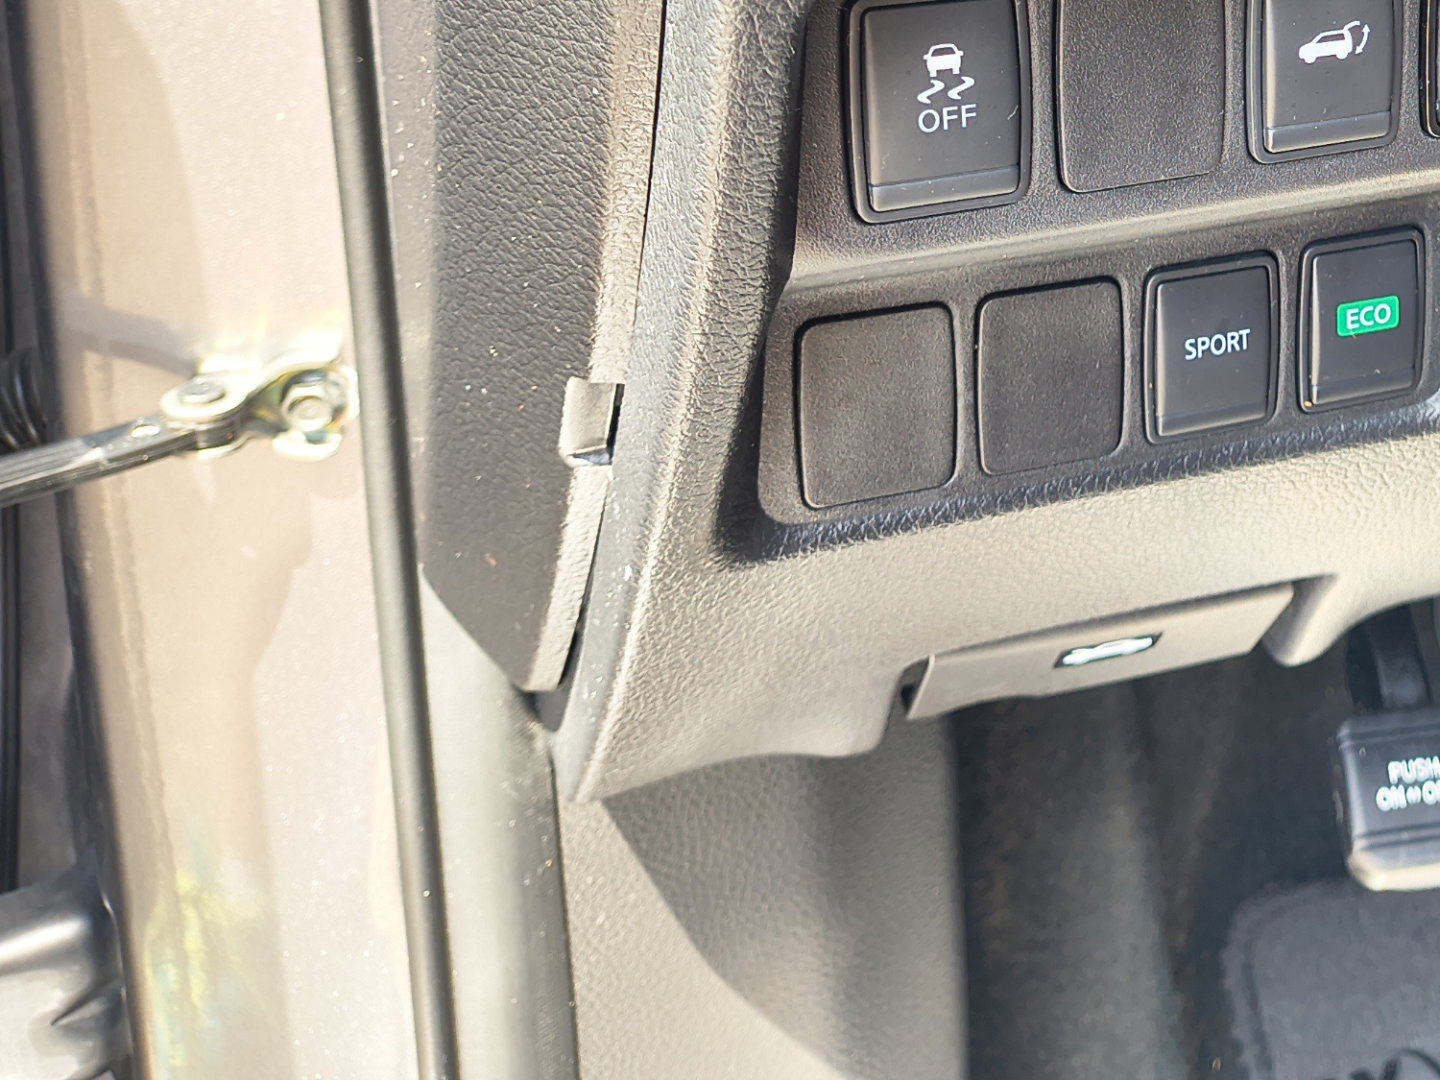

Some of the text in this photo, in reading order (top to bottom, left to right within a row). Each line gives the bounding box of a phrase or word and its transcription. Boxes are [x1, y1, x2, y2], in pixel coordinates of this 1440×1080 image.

[918, 103, 977, 133] OFF
[1346, 303, 1391, 329] ECO
[1185, 328, 1251, 360] SPORT
